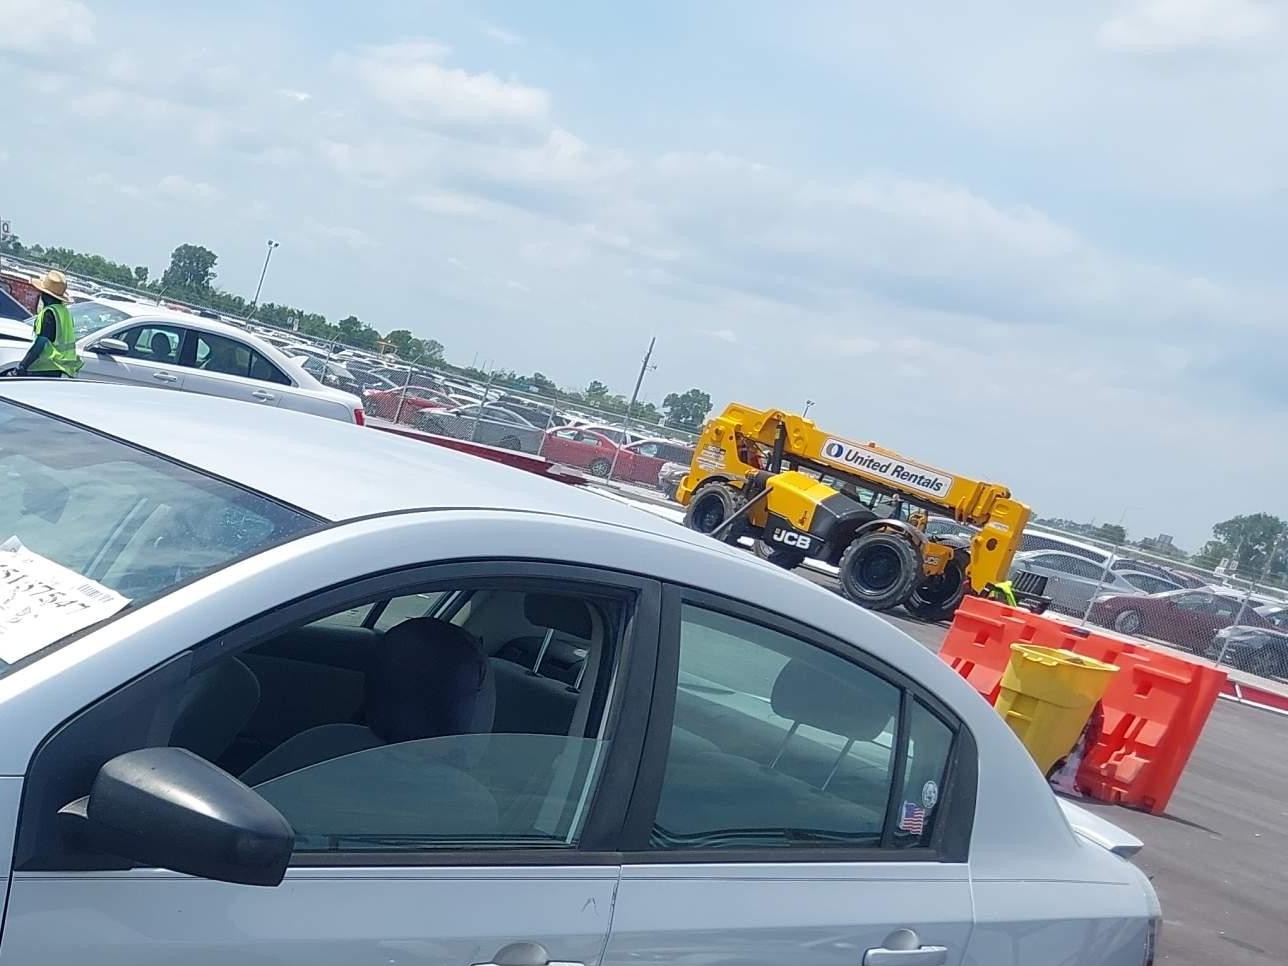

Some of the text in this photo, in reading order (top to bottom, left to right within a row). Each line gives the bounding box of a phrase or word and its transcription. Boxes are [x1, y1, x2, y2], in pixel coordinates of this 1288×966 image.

[844, 449, 944, 492] United Rentals
[772, 527, 812, 550] JCB
